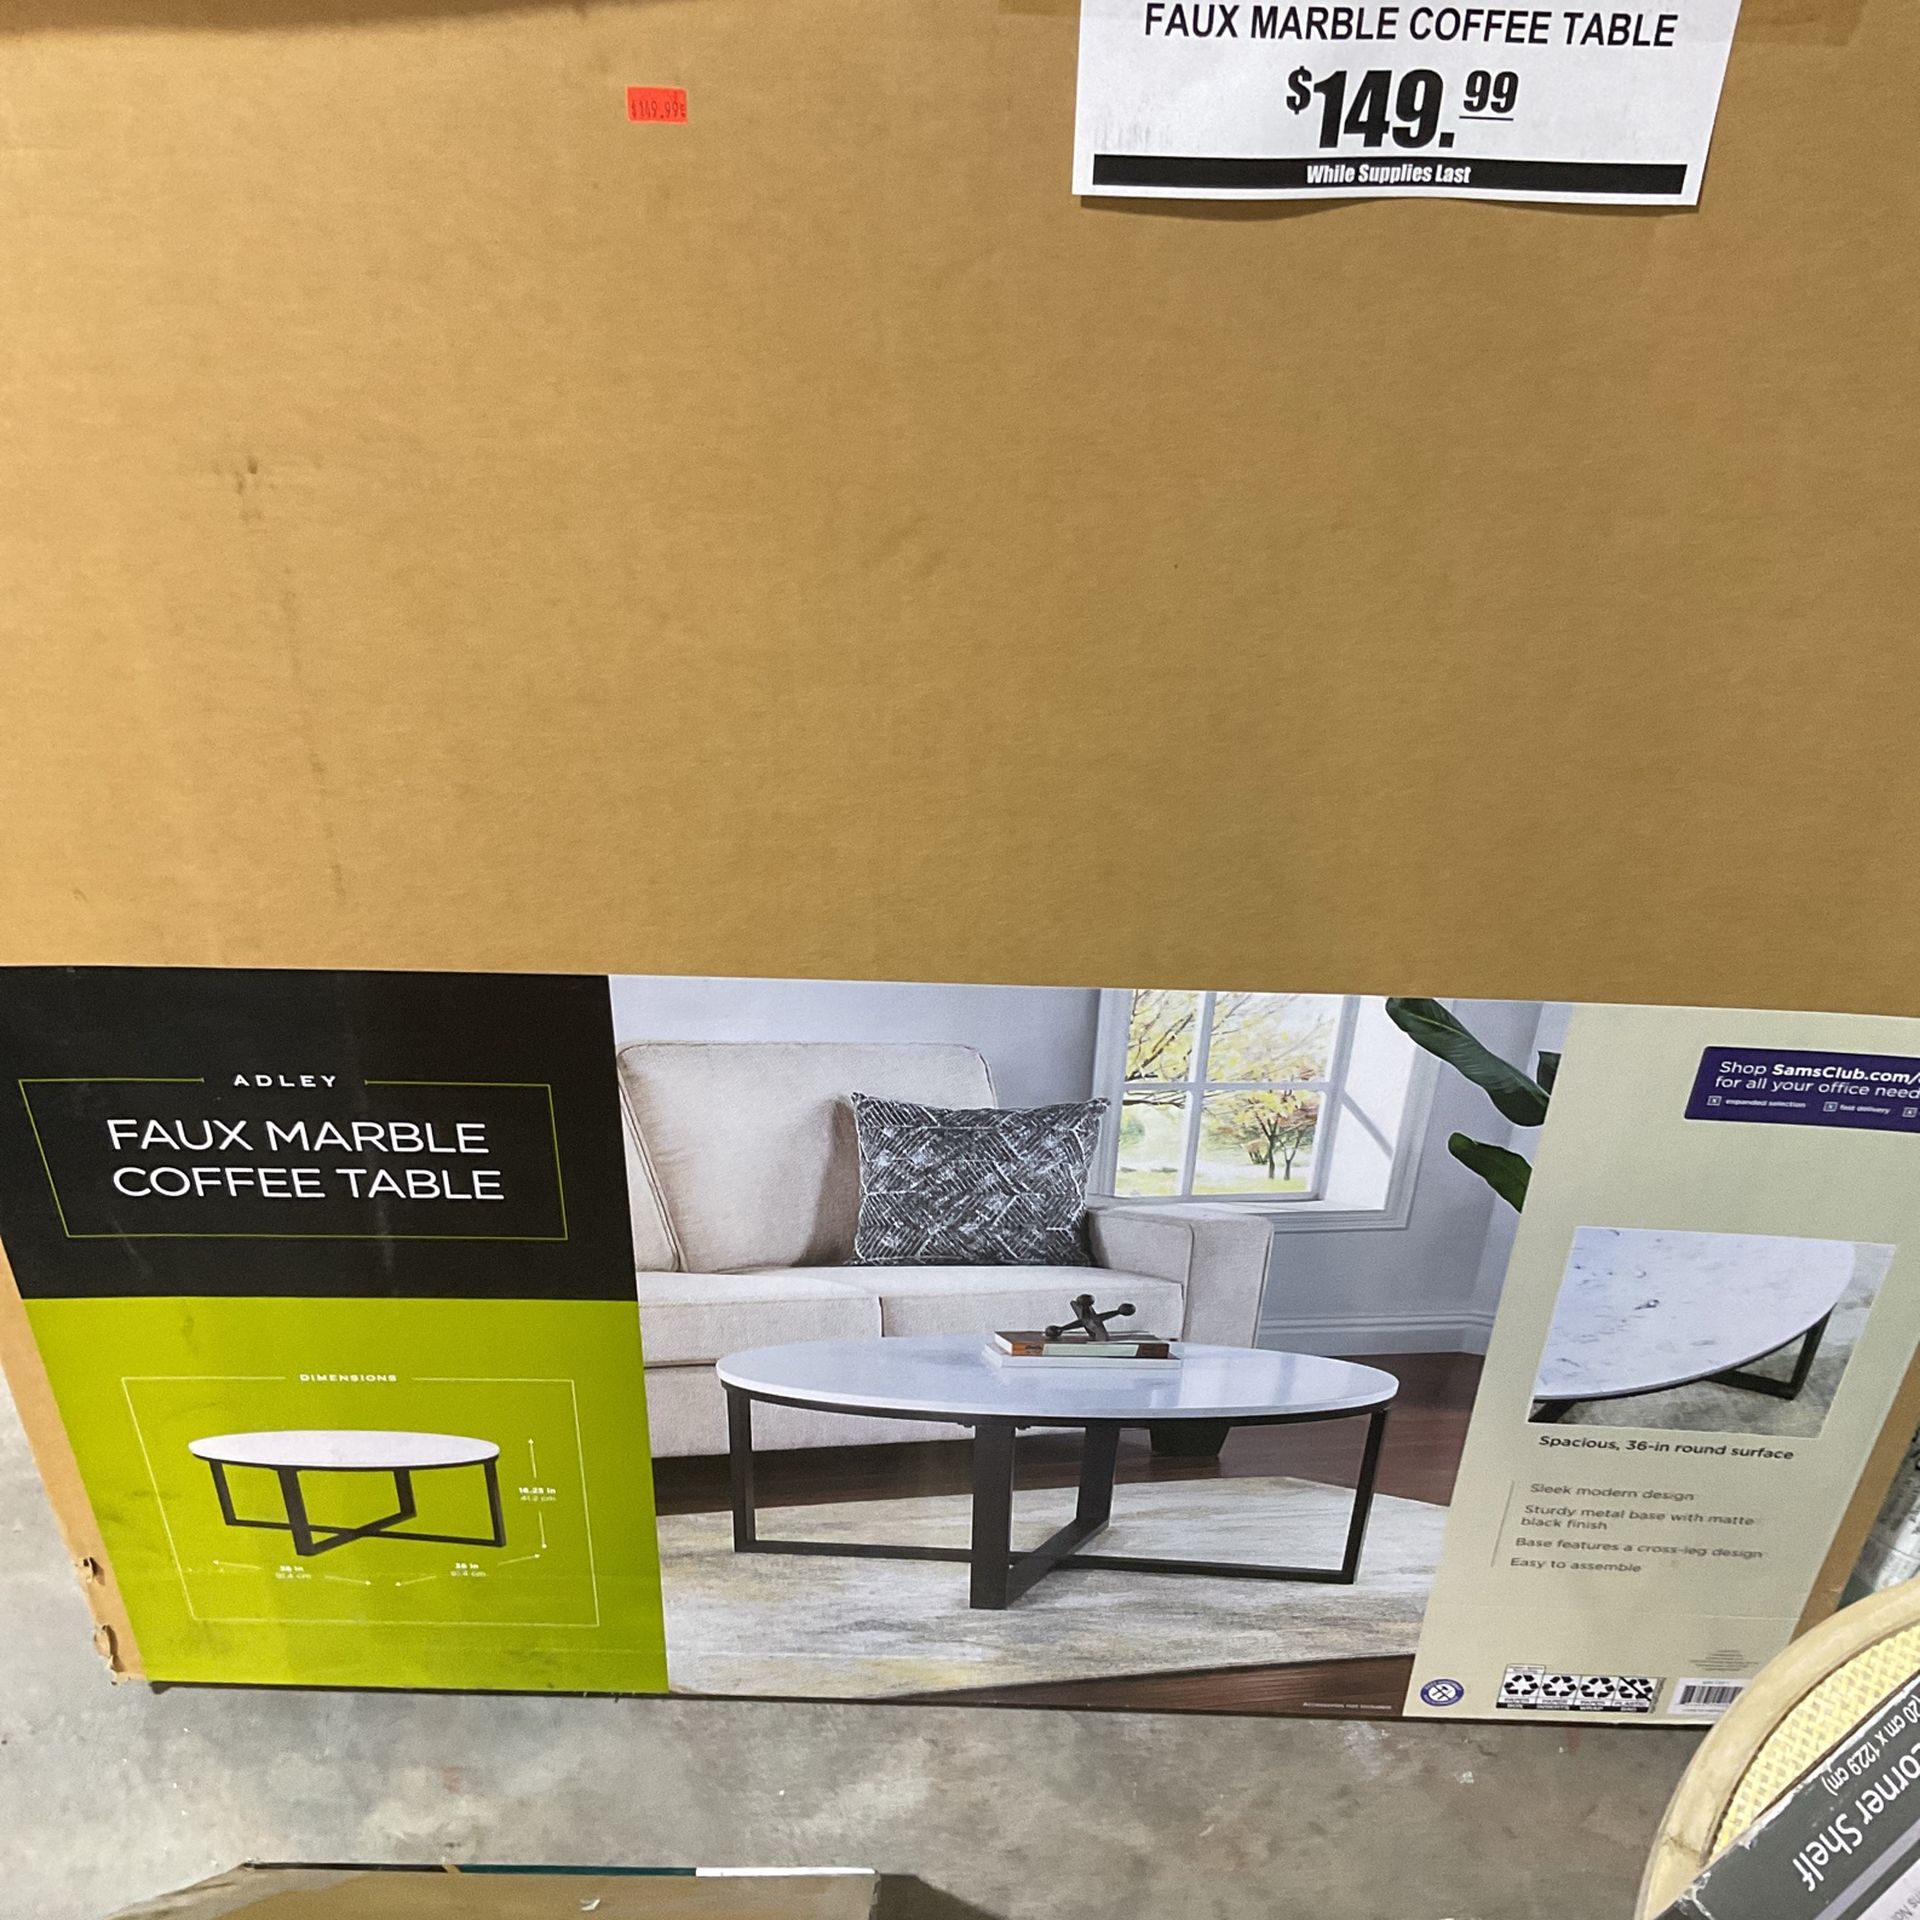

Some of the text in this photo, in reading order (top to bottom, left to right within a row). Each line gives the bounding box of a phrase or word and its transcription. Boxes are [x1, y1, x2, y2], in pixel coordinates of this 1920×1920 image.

[1145, 3, 1678, 46] FAUX MARBLE COFFEE TABLE
[1306, 163, 1472, 184] While Supplies Last
[233, 1074, 337, 1088] ADLEY
[1719, 1061, 1920, 1086] Shop SamsClub.com/
[1715, 1076, 1742, 1088] for
[1745, 1078, 1767, 1090] all
[1770, 1081, 1814, 1093] your
[1817, 1081, 1870, 1096] office
[106, 1119, 490, 1153] FAUX MARBLE
[112, 1166, 505, 1200] COFFEE TABLE
[299, 1373, 398, 1383] DIMENSIONS
[1538, 1435, 1795, 1460] Spacious, 36-in round surface
[1530, 1483, 1695, 1502] Sleek modern design
[1520, 1516, 1608, 1531] black finish
[1524, 1504, 1755, 1526] Sturdy metal base with matte
[1515, 1537, 1763, 1560] Base features a cross-leg design
[1510, 1557, 1643, 1573] Easy to assemble
[1883, 1715, 1906, 1738] cm
[1874, 1730, 1889, 1747] x
[1821, 1767, 1850, 1796] cm)
[1793, 1813, 1863, 1892] Shelf
